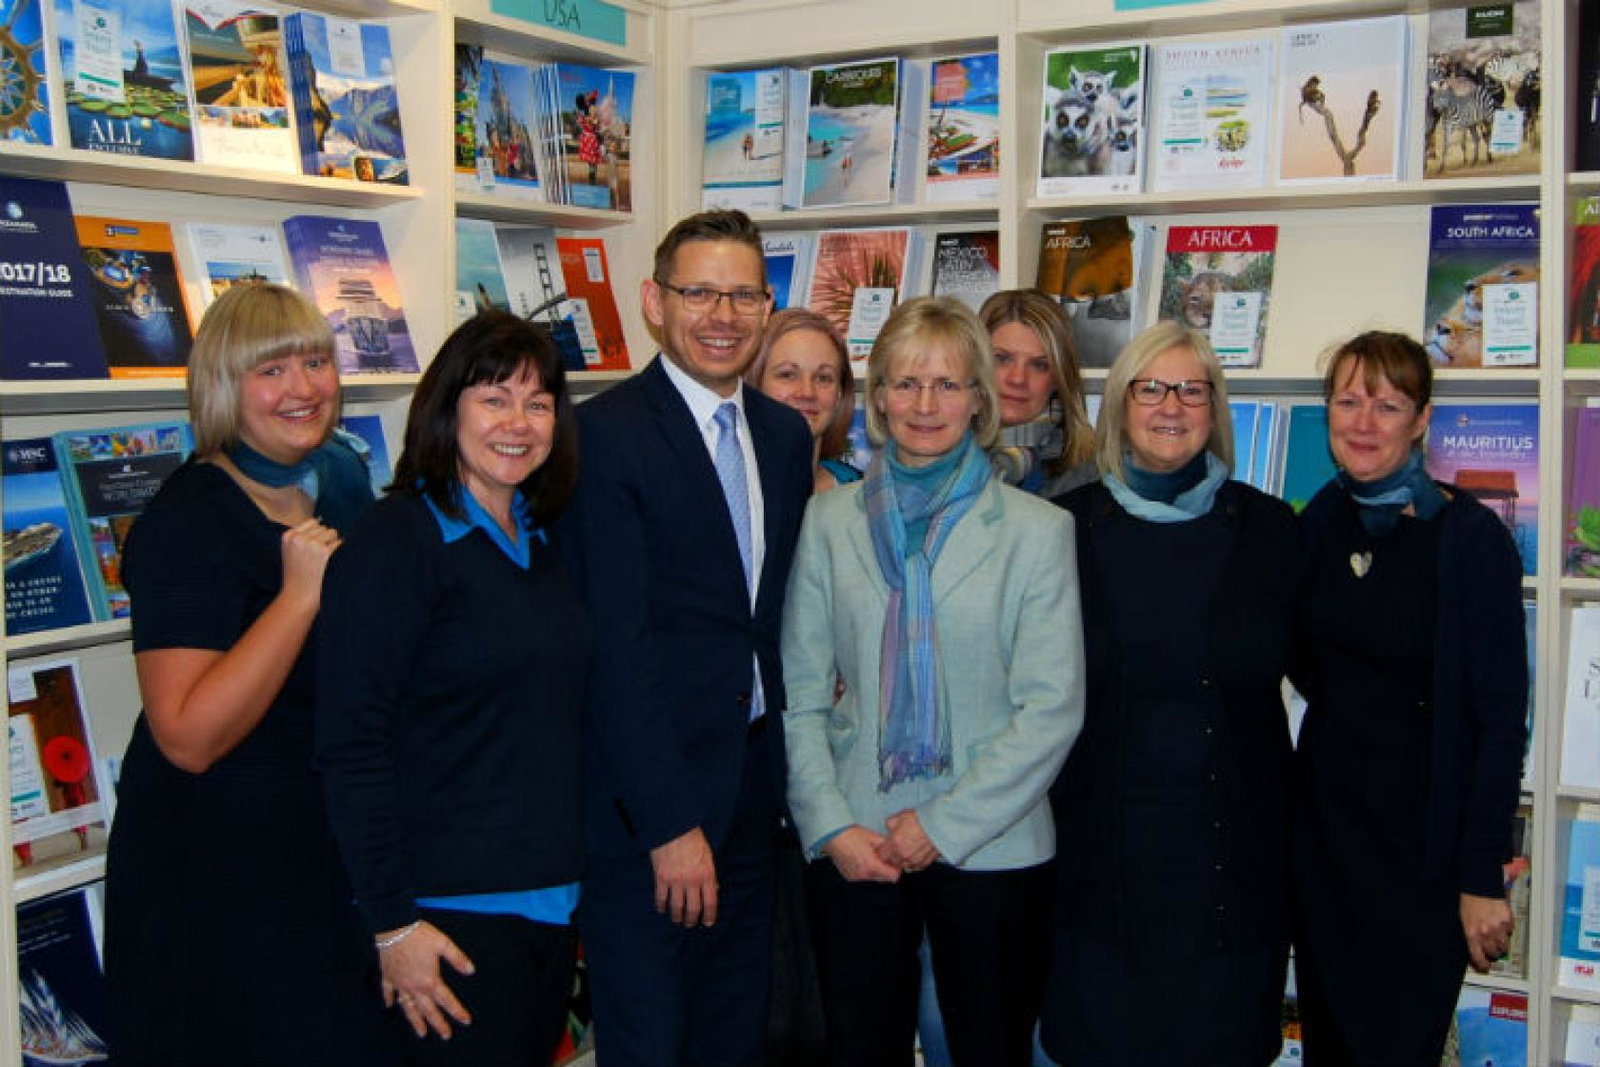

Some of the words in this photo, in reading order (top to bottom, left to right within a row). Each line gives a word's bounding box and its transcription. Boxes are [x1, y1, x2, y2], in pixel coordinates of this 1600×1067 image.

[543, 0, 581, 30] USA
[88, 119, 142, 145] ALL
[1187, 229, 1253, 247] AFRICA
[1447, 227, 1488, 238] SOUTH
[1491, 226, 1534, 238] AFRICA
[1045, 236, 1091, 249] AFRICA
[0, 262, 71, 286] 017/18
[1442, 434, 1534, 449] MAURITIUS
